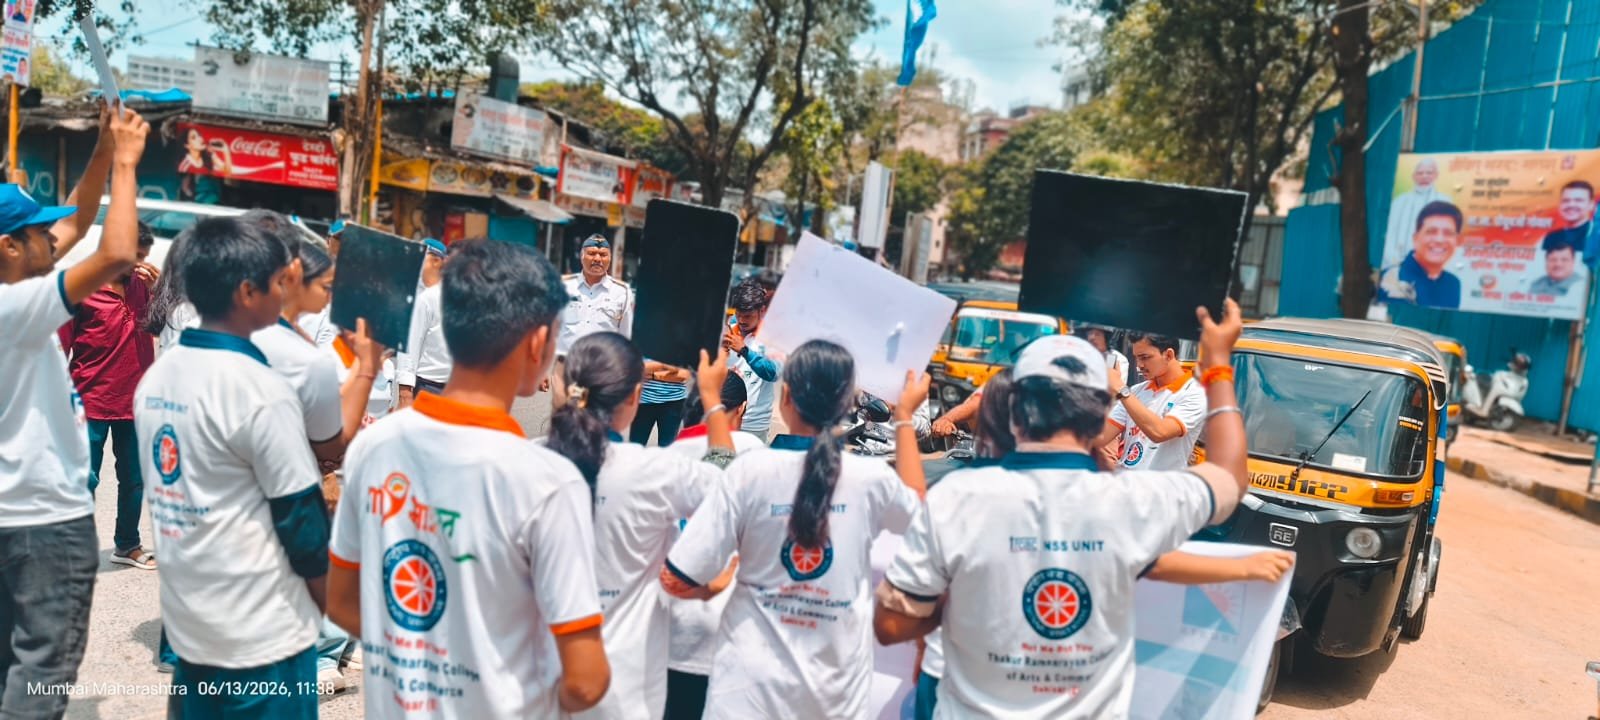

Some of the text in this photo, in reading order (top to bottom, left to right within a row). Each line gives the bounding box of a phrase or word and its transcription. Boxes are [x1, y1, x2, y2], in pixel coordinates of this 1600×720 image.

[1273, 530, 1292, 543] RE
[1044, 541, 1068, 552] NSS
[1072, 541, 1104, 552] UNIT
